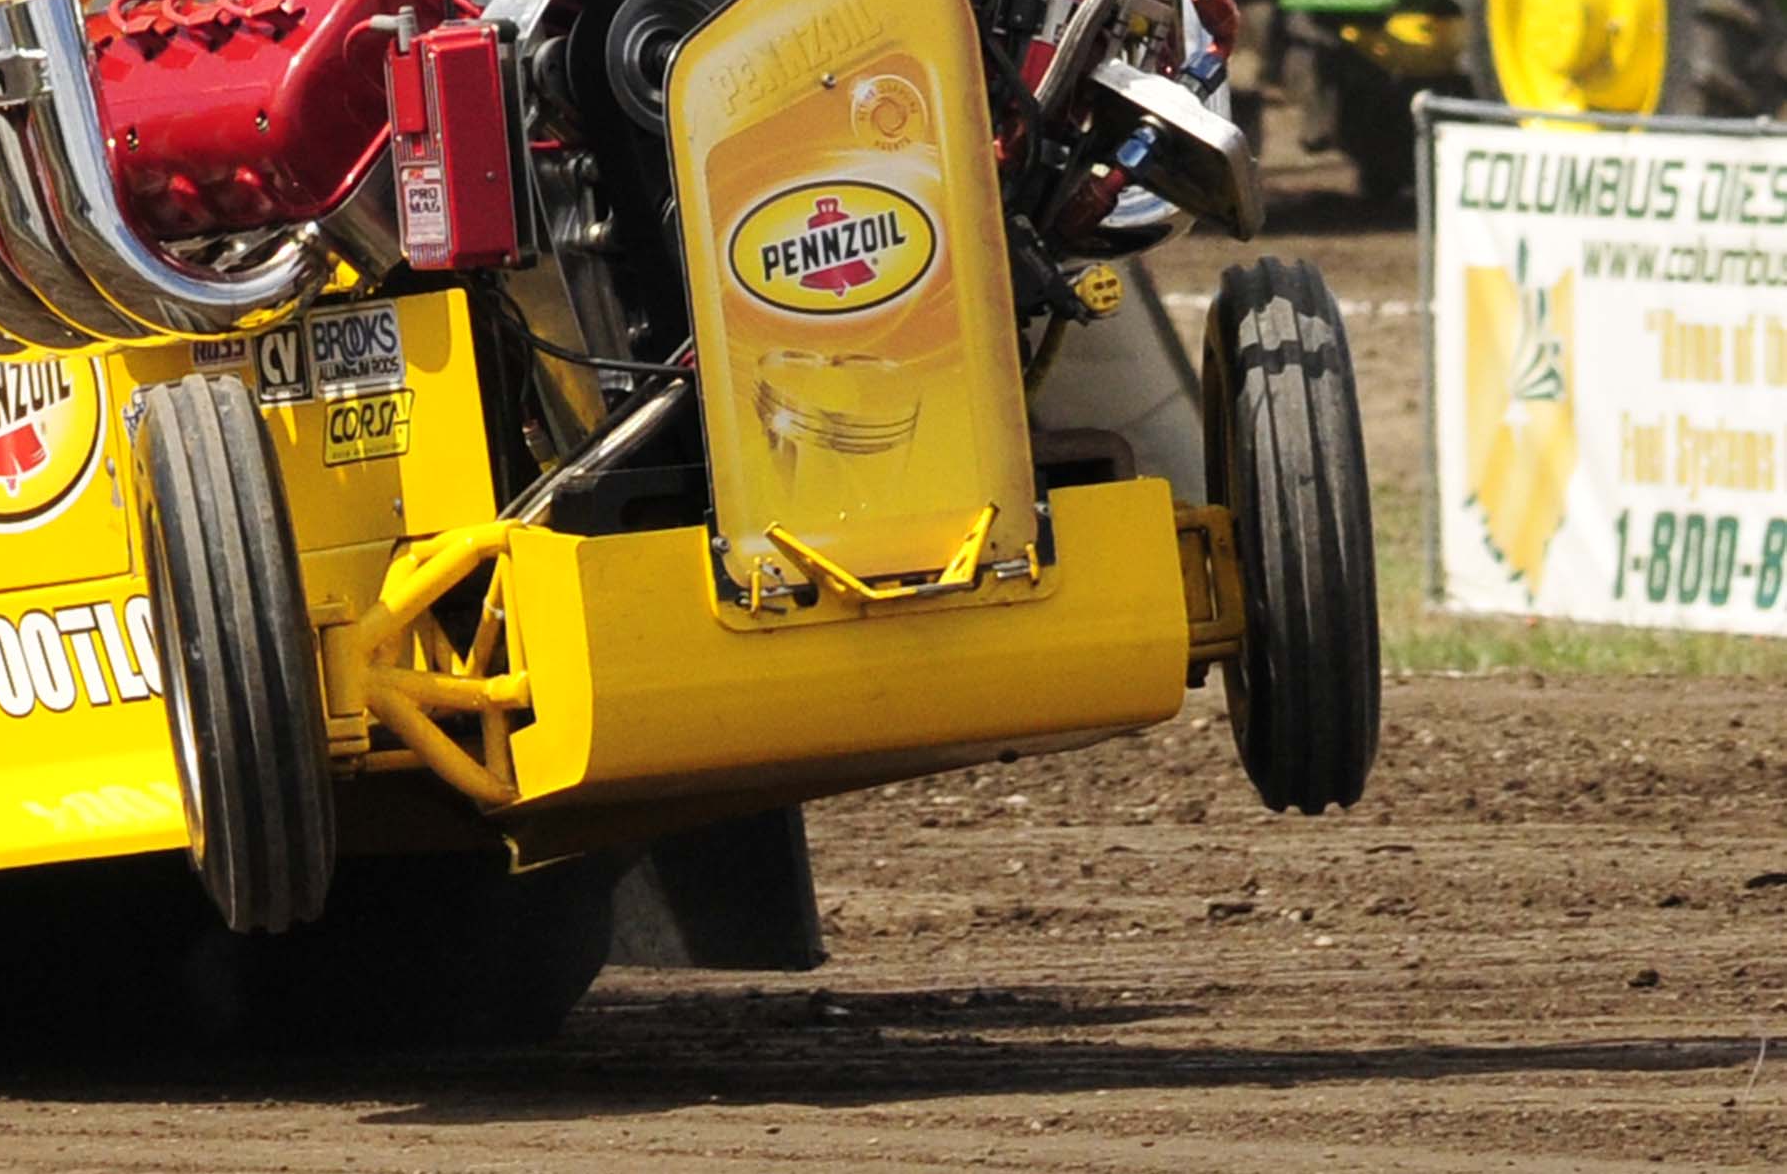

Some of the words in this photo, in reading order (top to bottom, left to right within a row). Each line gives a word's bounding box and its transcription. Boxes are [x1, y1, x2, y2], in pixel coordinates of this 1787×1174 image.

[408, 187, 439, 201] PRO
[1460, 150, 1685, 219] COLUMBUS
[761, 209, 907, 282] PENNZOIL
[260, 331, 297, 384] CV
[311, 311, 398, 365] BROOKS
[371, 356, 400, 375] RODS
[330, 399, 411, 445] CORSA
